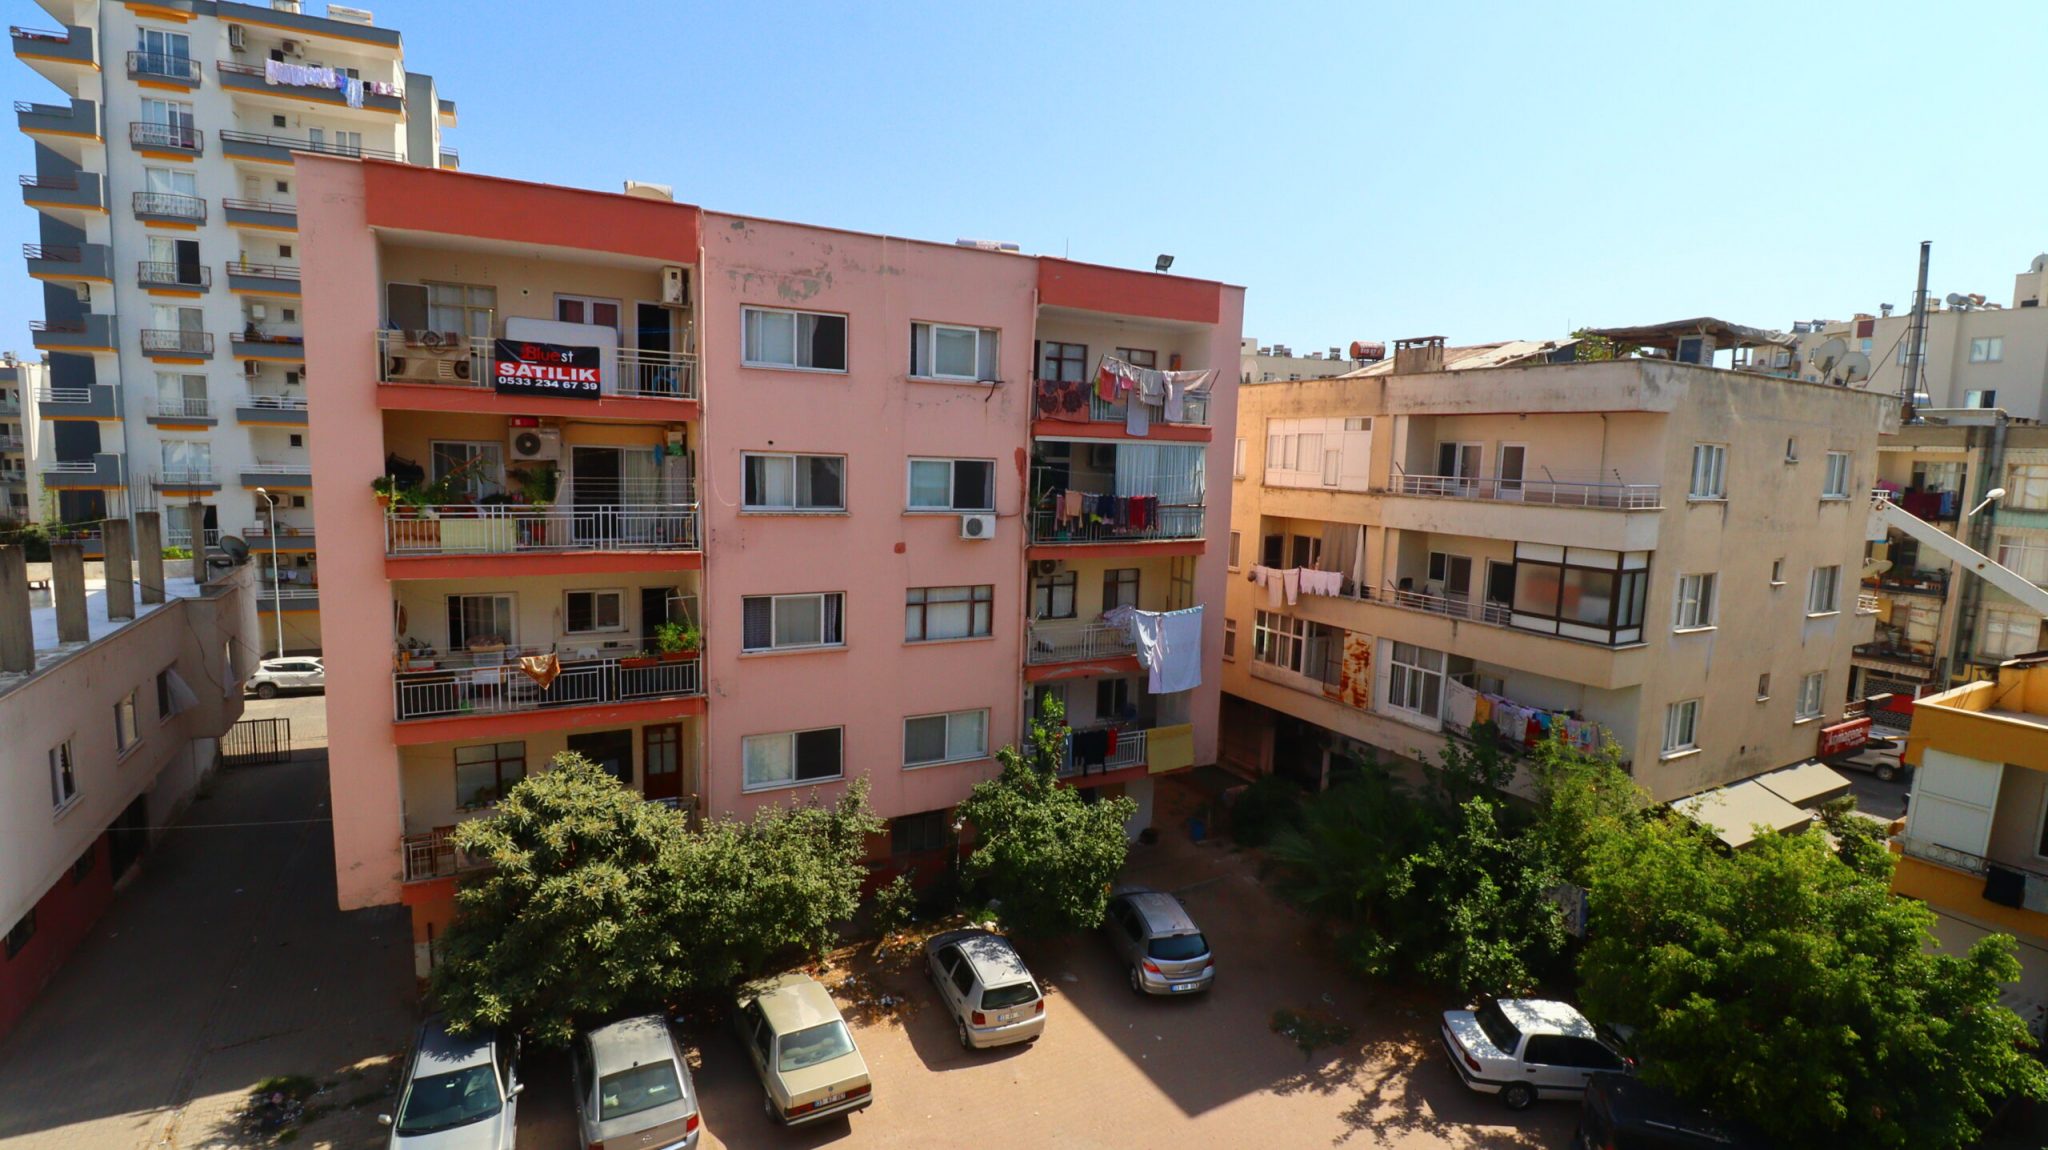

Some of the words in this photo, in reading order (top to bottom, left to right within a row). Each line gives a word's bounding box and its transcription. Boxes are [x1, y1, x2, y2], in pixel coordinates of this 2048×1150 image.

[500, 363, 596, 381] SATILIK
[498, 376, 531, 386] 0533
[535, 379, 559, 388] 234
[563, 381, 578, 390] 67
[582, 382, 598, 391] 39
